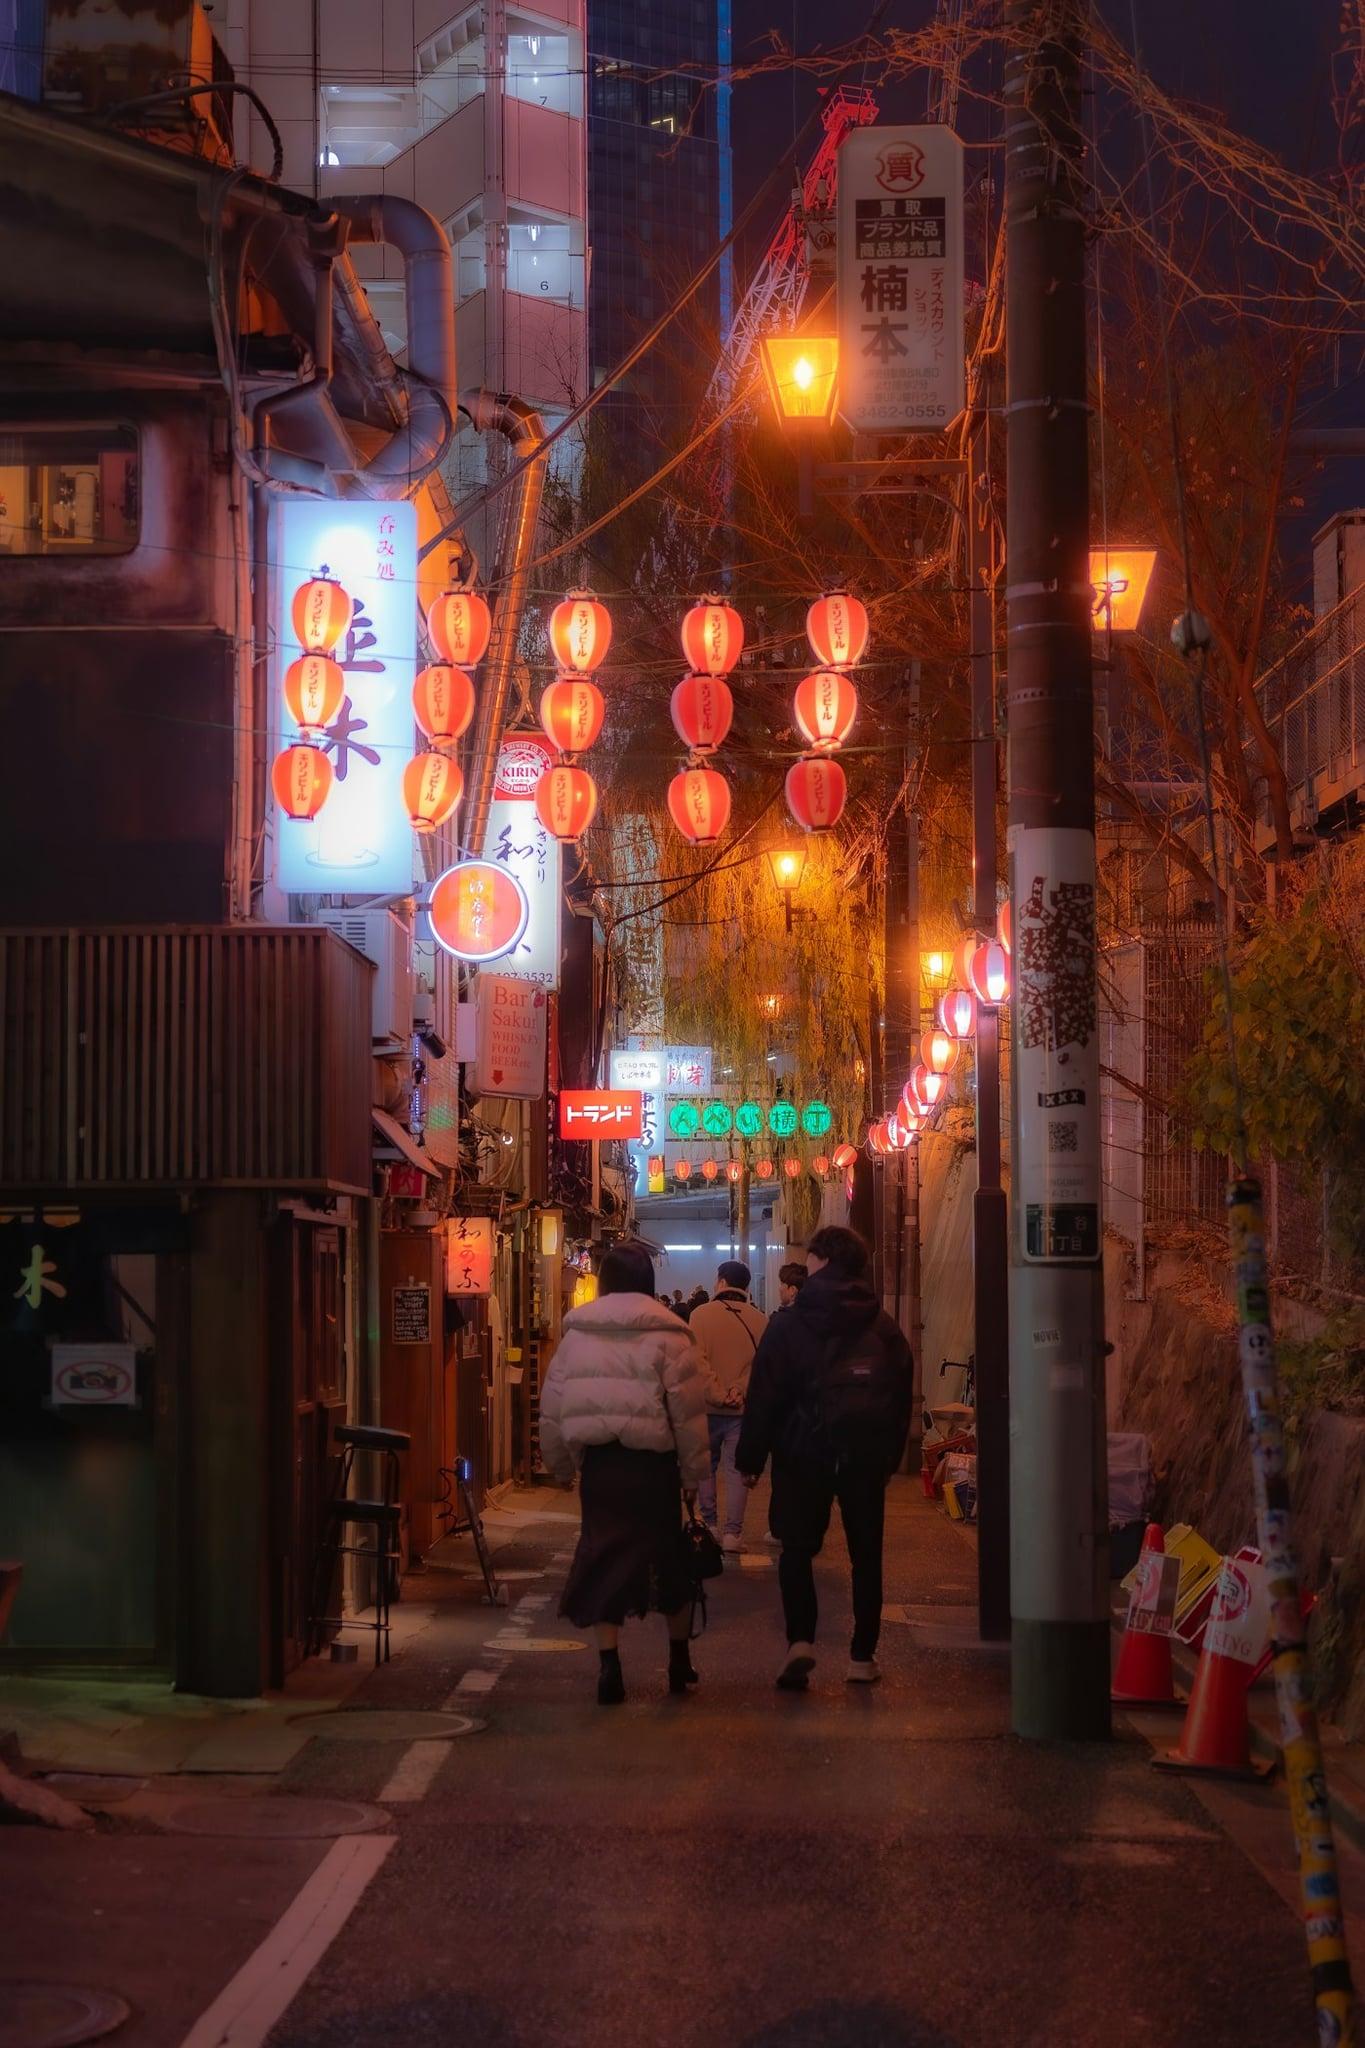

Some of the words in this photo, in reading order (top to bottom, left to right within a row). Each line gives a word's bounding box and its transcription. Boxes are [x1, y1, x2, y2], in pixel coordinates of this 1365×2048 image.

[886, 152, 914, 182] 質
[880, 199, 922, 217] 買取
[863, 220, 939, 239] ブランド品
[539, 280, 549, 292] 6
[860, 264, 909, 364] 楠本
[929, 267, 945, 361] ディスカウント
[577, 609, 588, 657] キリンビール
[711, 613, 722, 661] キリンビール
[831, 601, 845, 649] キリンビール
[701, 682, 713, 731] キリンビール
[820, 675, 833, 721] キリンビール
[577, 690, 588, 739] キリンビール
[502, 767, 539, 777] KIRIN
[494, 986, 529, 1008] Bar
[490, 1055, 518, 1068] BEER
[491, 1043, 520, 1055] FOOD
[566, 1105, 633, 1124] トランド
